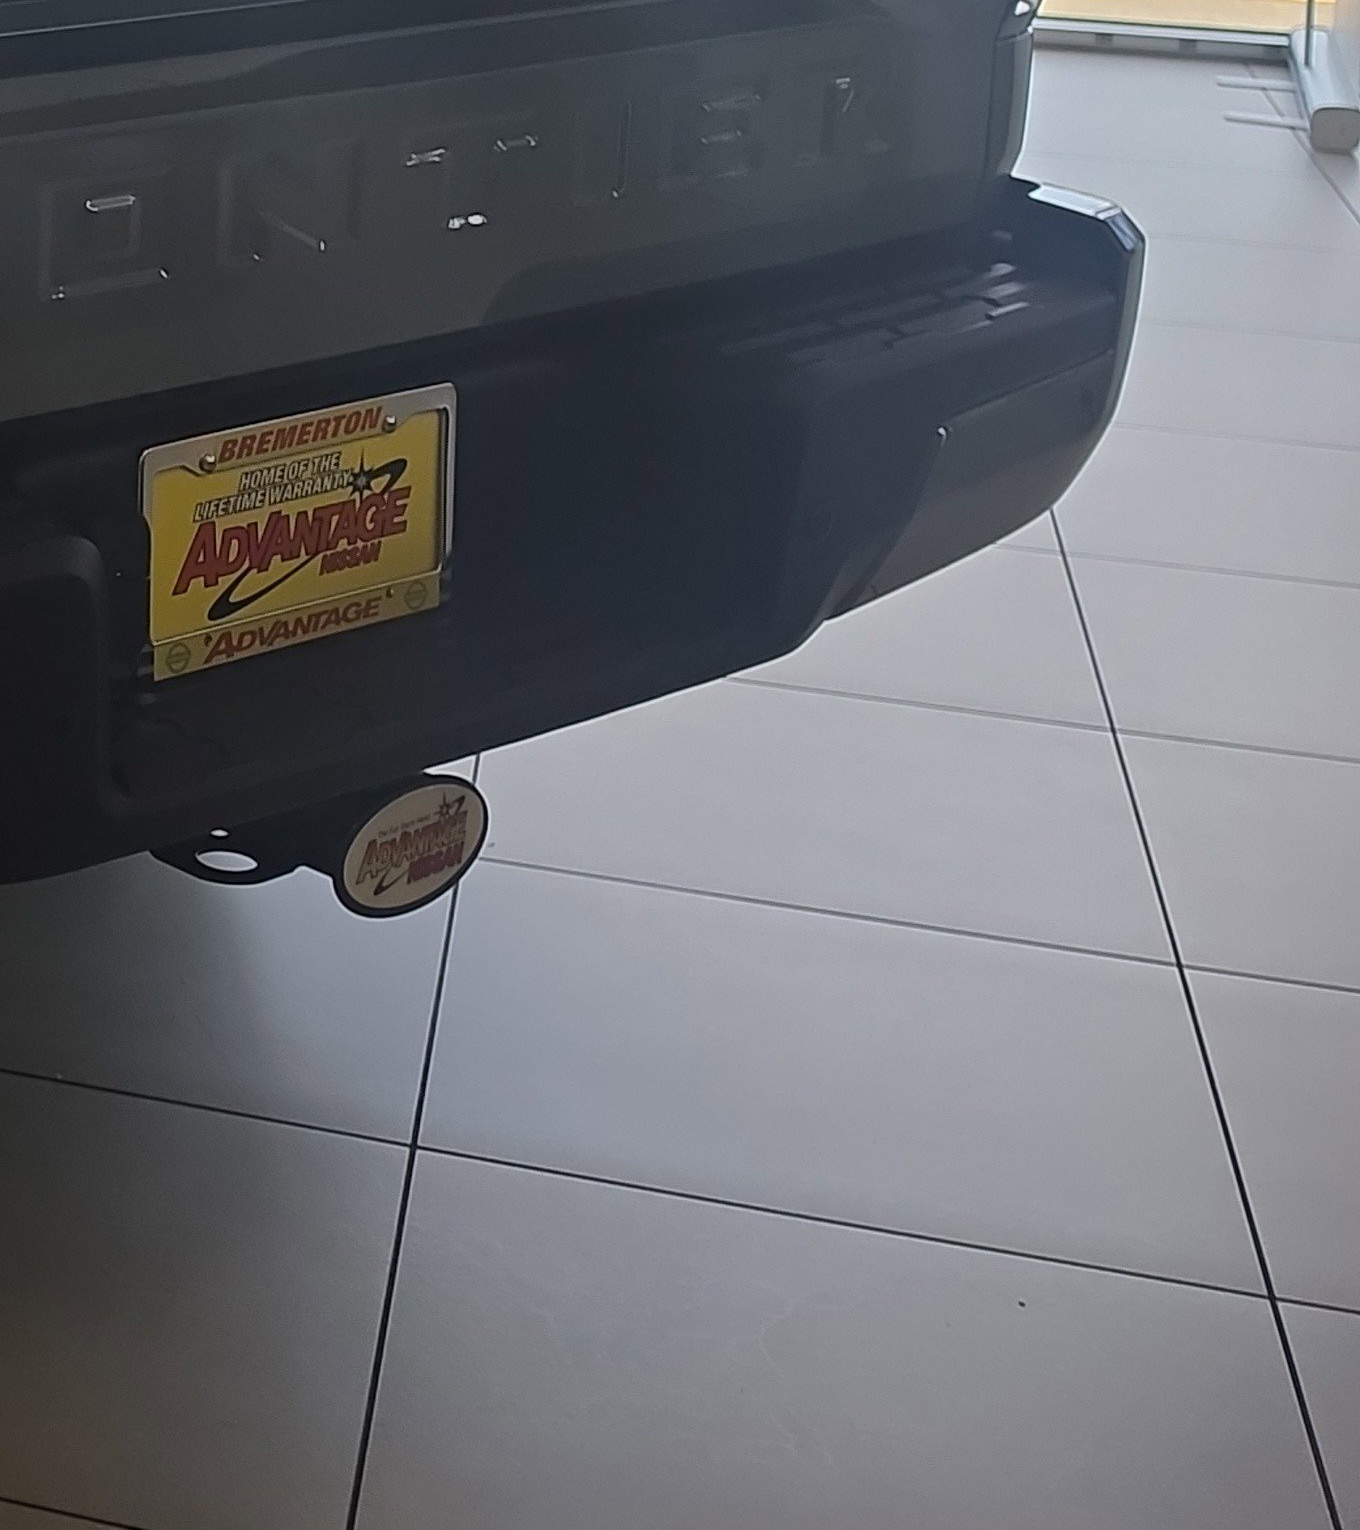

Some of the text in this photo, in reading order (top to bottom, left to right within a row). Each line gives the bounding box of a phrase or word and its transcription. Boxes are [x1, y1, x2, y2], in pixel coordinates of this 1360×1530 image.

[217, 406, 382, 462] BREMERTON
[193, 471, 353, 522] LIFETIME WARRANTY
[239, 452, 341, 491] HOME OF THE
[172, 485, 411, 596] ADVANTAGE
[202, 598, 382, 664] ADVANTAGE
